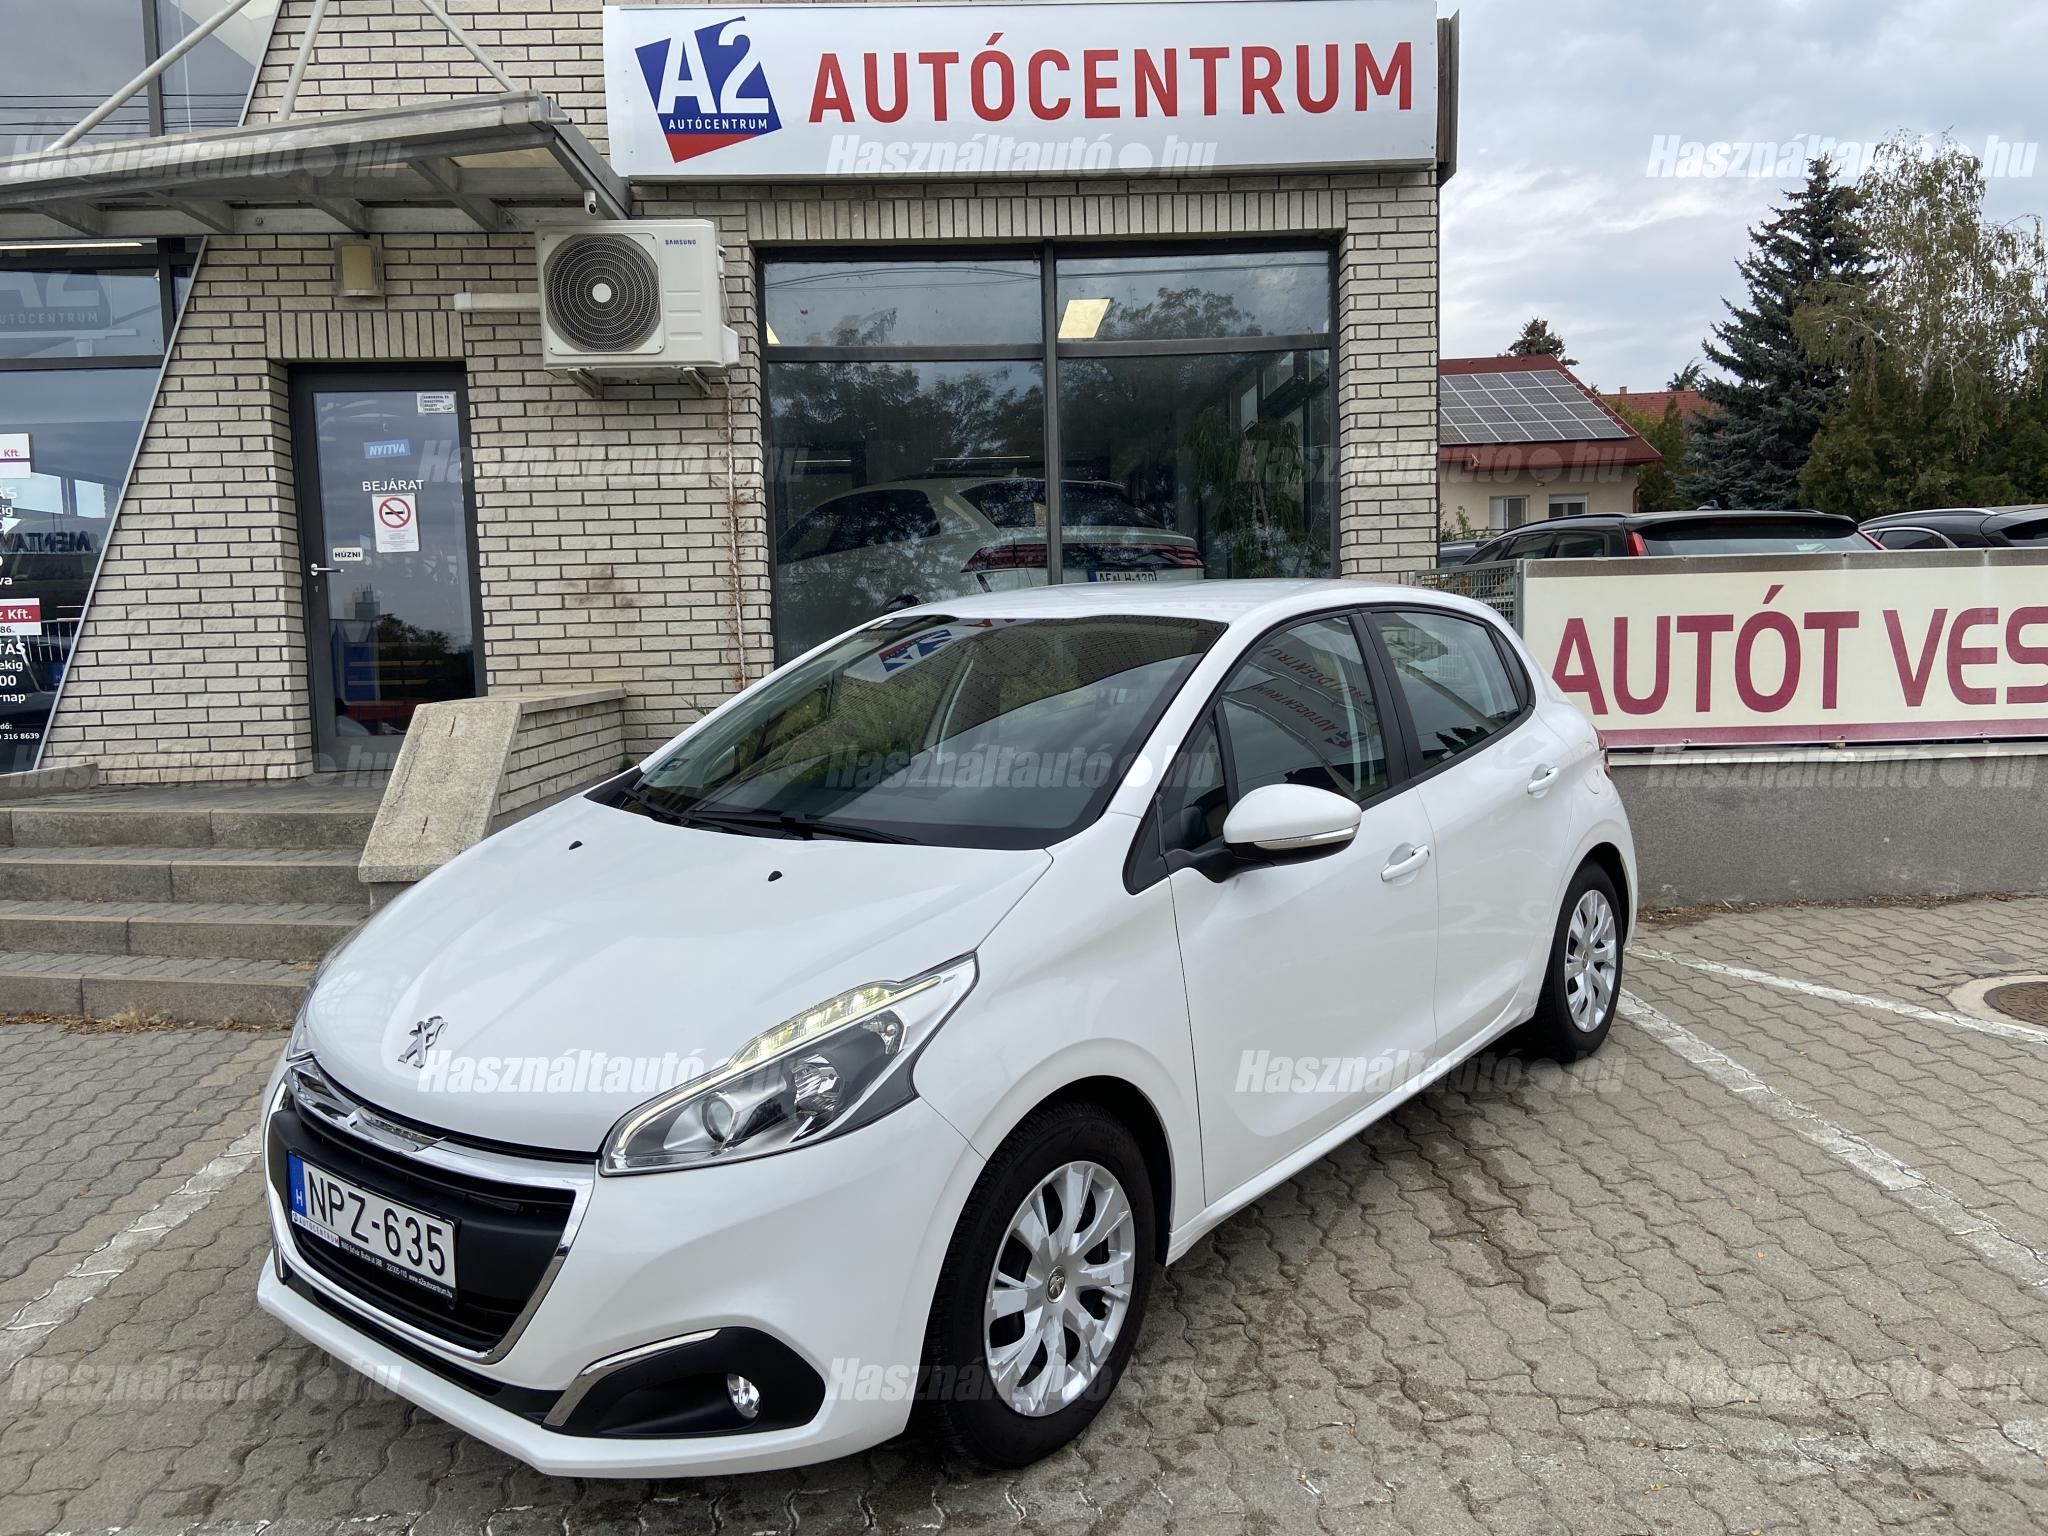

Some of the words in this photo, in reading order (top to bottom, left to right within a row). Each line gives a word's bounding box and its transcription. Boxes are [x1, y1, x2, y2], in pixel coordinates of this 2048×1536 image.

[657, 20, 769, 114] A2
[809, 32, 1413, 124] AUTÓCENTRUM
[669, 116, 768, 130] AUTÓCENTRUM
[369, 444, 406, 456] NYITVA
[362, 478, 424, 491] BEJÁRAT
[7, 608, 32, 620] Kft.
[1552, 585, 1860, 715] AUTÓT
[308, 1170, 445, 1276] NPZ-635
